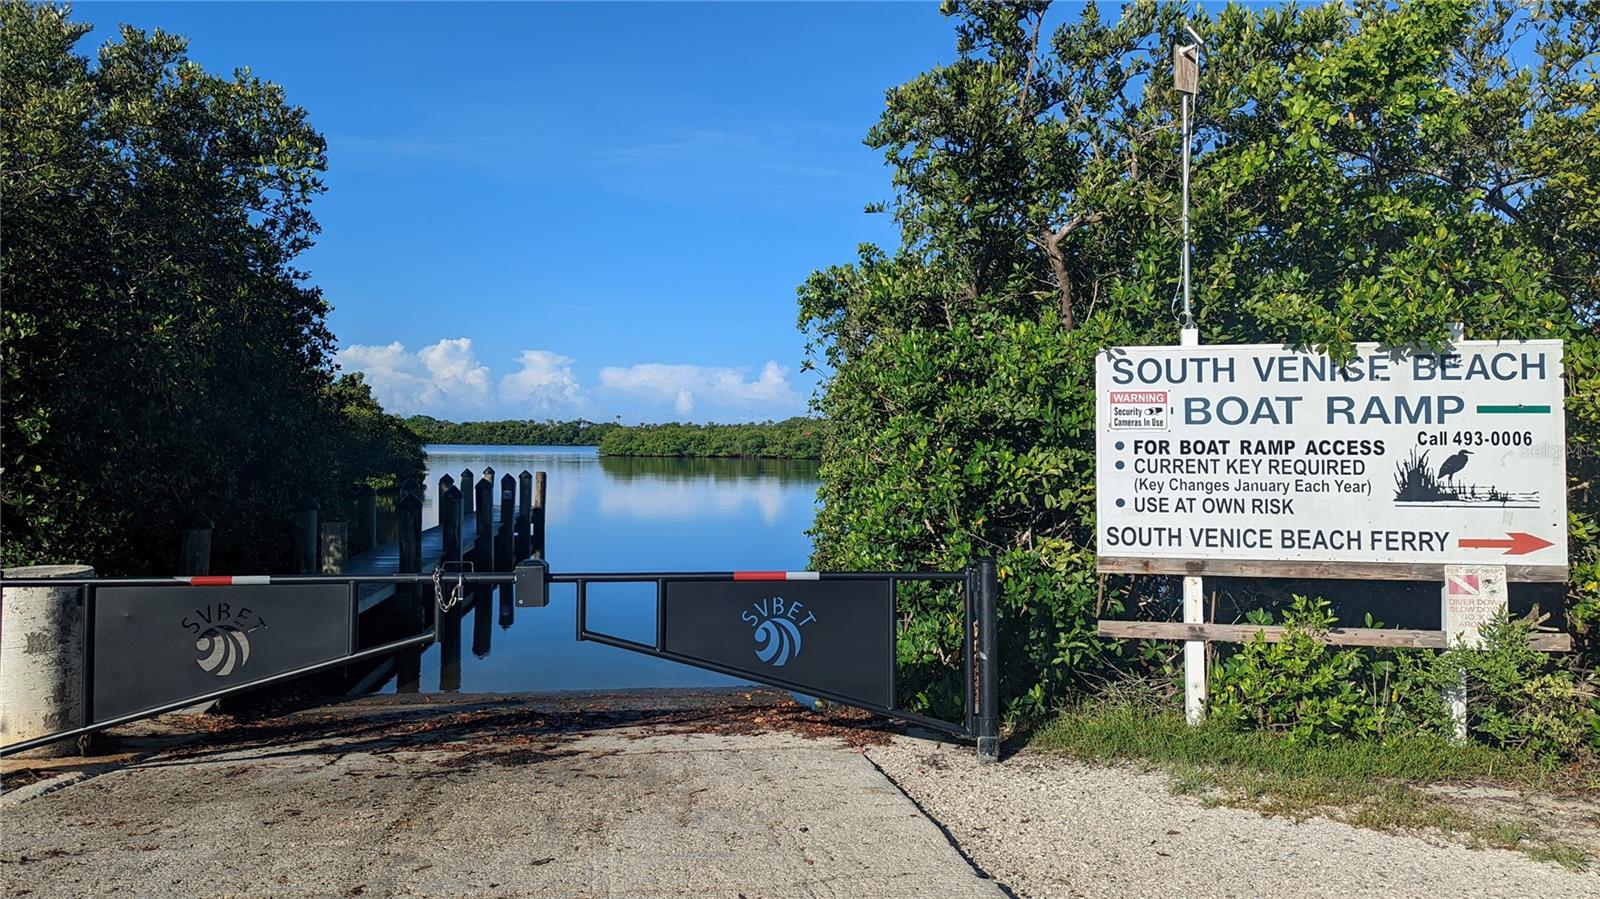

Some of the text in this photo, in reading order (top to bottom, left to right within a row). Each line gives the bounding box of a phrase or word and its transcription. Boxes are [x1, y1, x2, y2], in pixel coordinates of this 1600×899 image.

[1112, 357, 1235, 384] SOUTH
[1413, 352, 1546, 381] BEACH
[1113, 393, 1164, 402] WARNING
[1114, 406, 1142, 417] Security
[1184, 395, 1465, 425] BOAT RAMP
[1114, 417, 1164, 427] Cameras In Use
[1417, 430, 1533, 446] Call 493-0006
[1133, 440, 1385, 455] FOR BOAT RAMP ACCESS
[1134, 458, 1365, 476] CURRENT KEY REQUIRED
[1134, 478, 1372, 496] (Key Changes January Each Year)
[1134, 497, 1294, 514] USE AT OWN RISK
[1106, 526, 1450, 551] SOUTH VENICE BEACH FERRY
[181, 603, 268, 634] SVBET
[742, 597, 816, 627] SVBET
